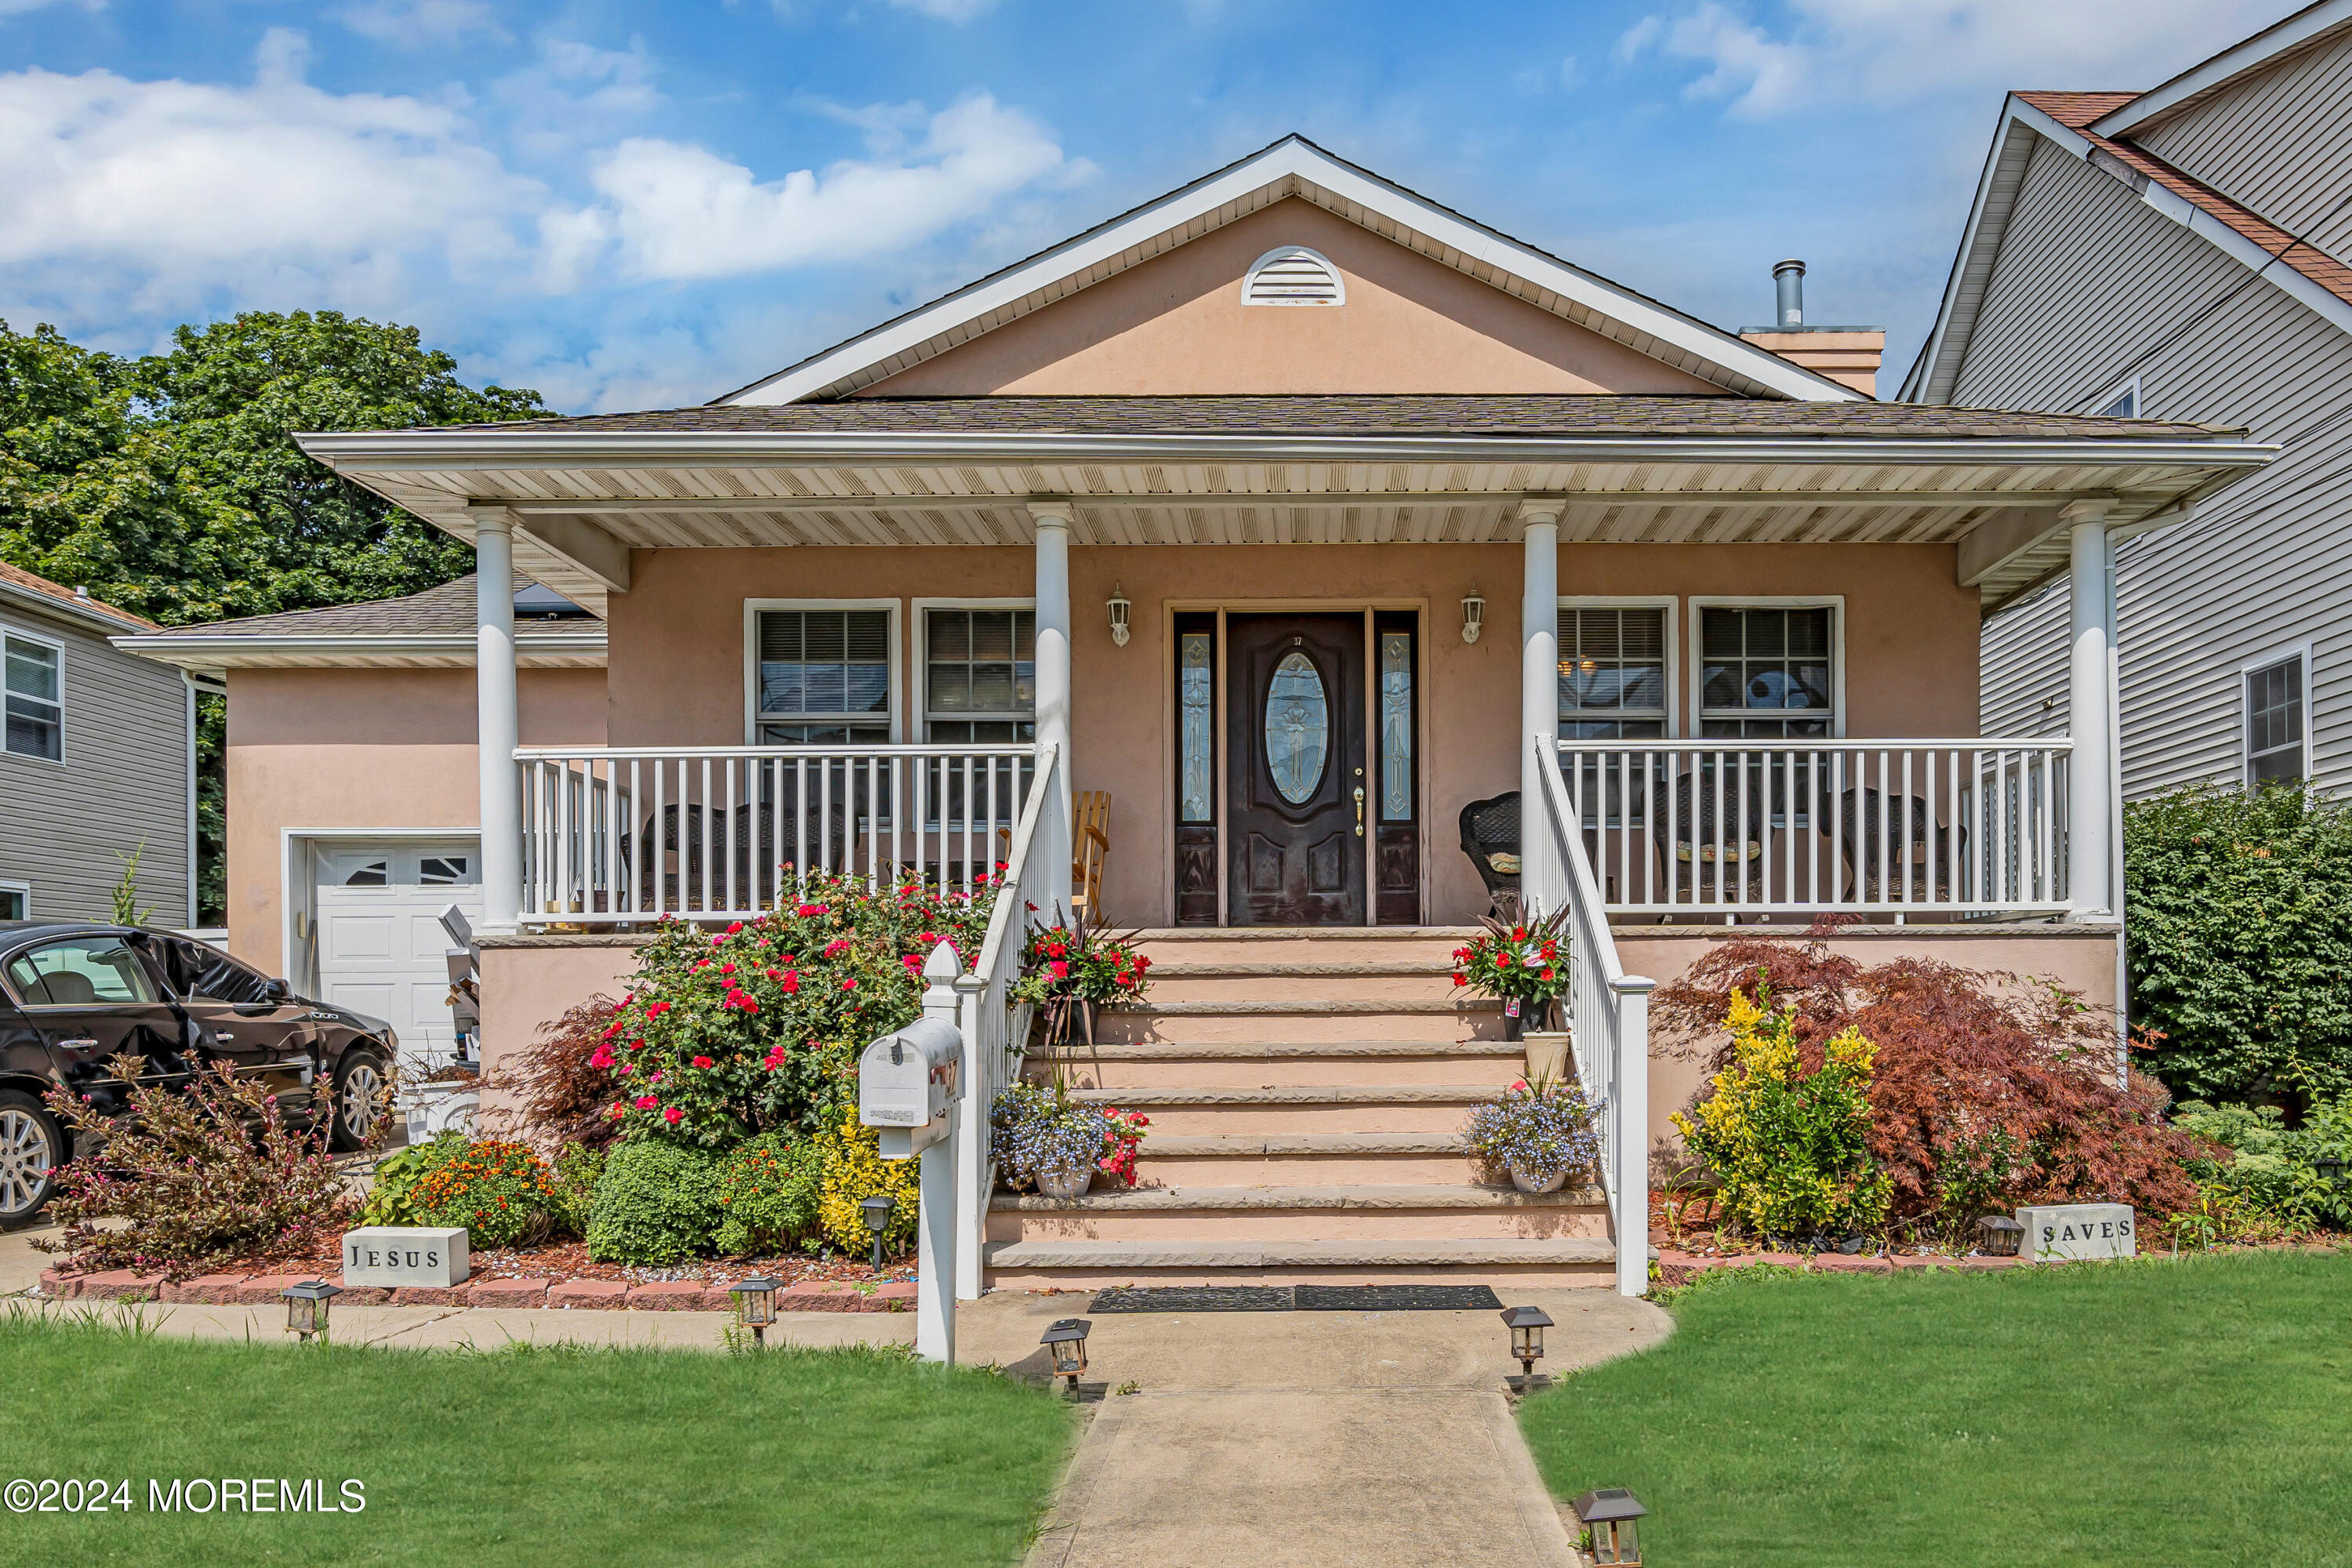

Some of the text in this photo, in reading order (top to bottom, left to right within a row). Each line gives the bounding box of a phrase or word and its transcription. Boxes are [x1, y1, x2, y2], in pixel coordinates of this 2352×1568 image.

[1294, 637, 1302, 646] 37
[947, 1059, 958, 1094] 37
[2043, 1220, 2130, 1243] SAVES
[350, 1246, 439, 1268] JESUS
